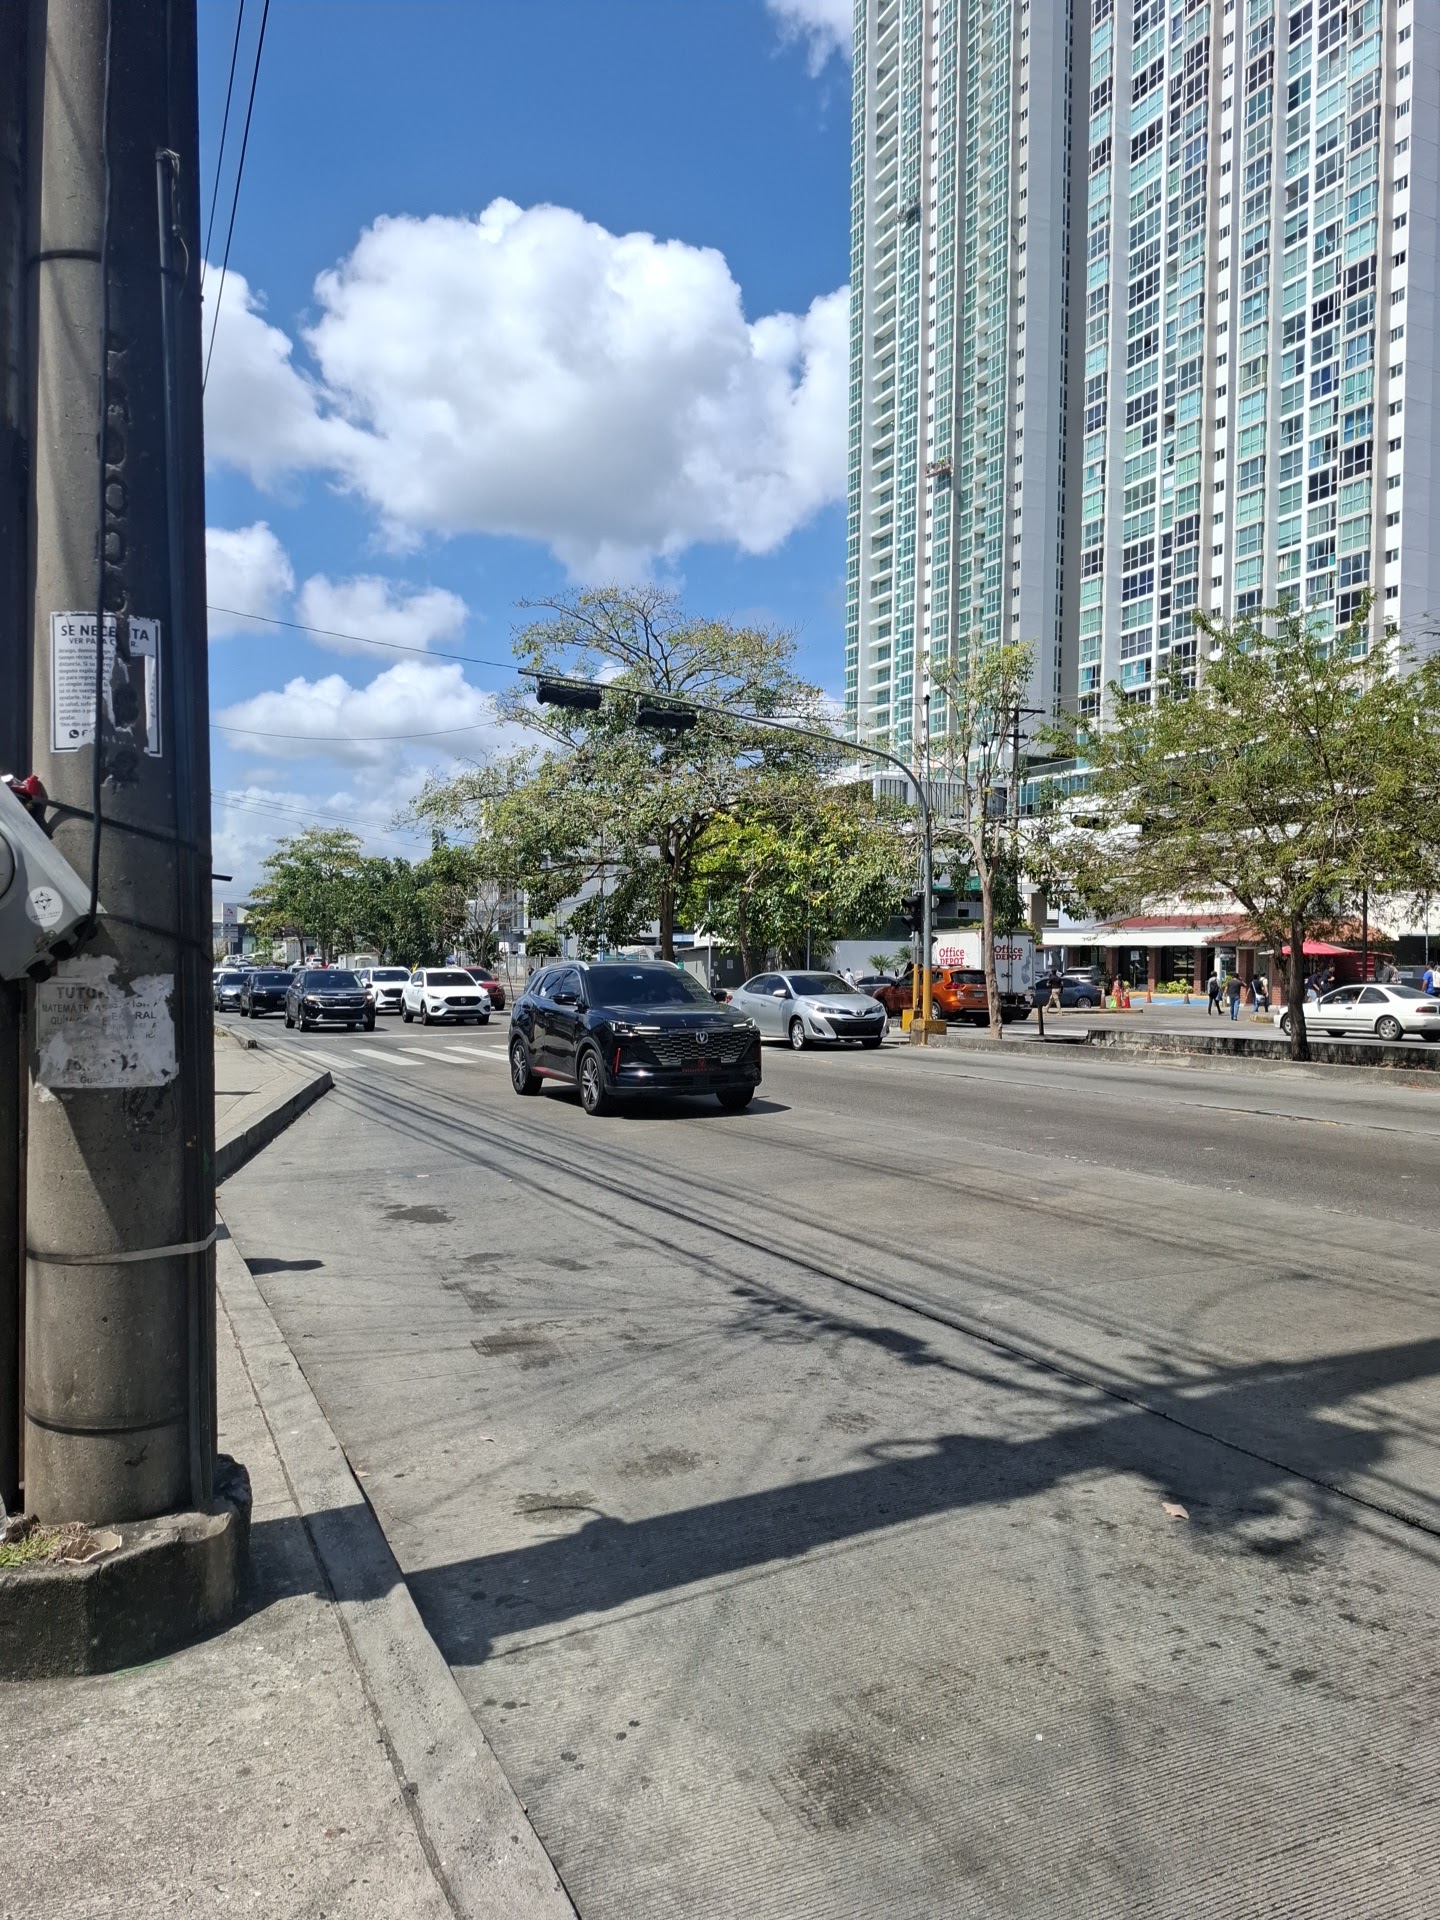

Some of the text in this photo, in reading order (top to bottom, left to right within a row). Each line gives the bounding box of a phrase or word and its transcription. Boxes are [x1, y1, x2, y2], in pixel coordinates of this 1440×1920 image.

[61, 625, 149, 642] SE NECETA
[939, 947, 965, 958] Office
[994, 945, 1023, 954] Office
[940, 957, 965, 965] DEPOT
